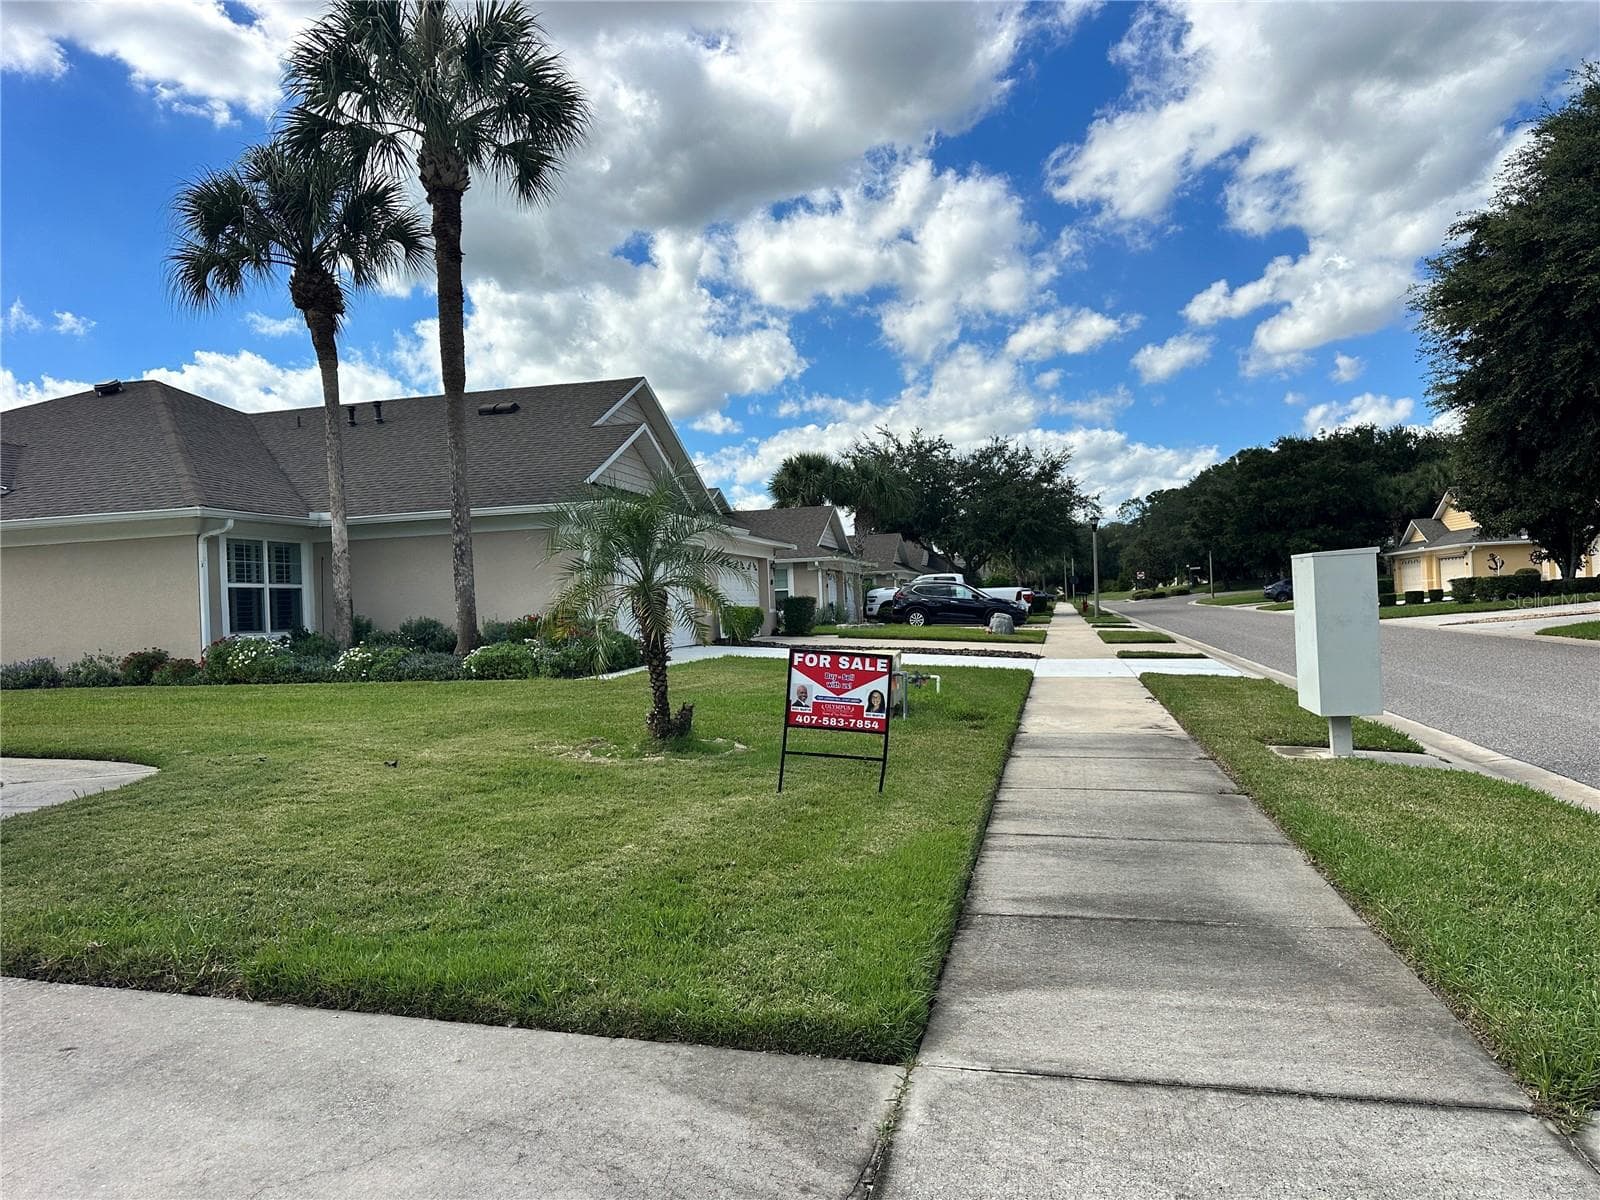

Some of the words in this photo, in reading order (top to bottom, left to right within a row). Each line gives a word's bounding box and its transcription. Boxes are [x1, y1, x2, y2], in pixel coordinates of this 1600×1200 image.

[793, 653, 831, 668] FOR
[838, 656, 888, 672] SALE
[824, 672, 838, 681] Buy
[842, 673, 855, 681] Sell
[826, 681, 841, 689] with
[795, 715, 879, 729] 407-583-7854
